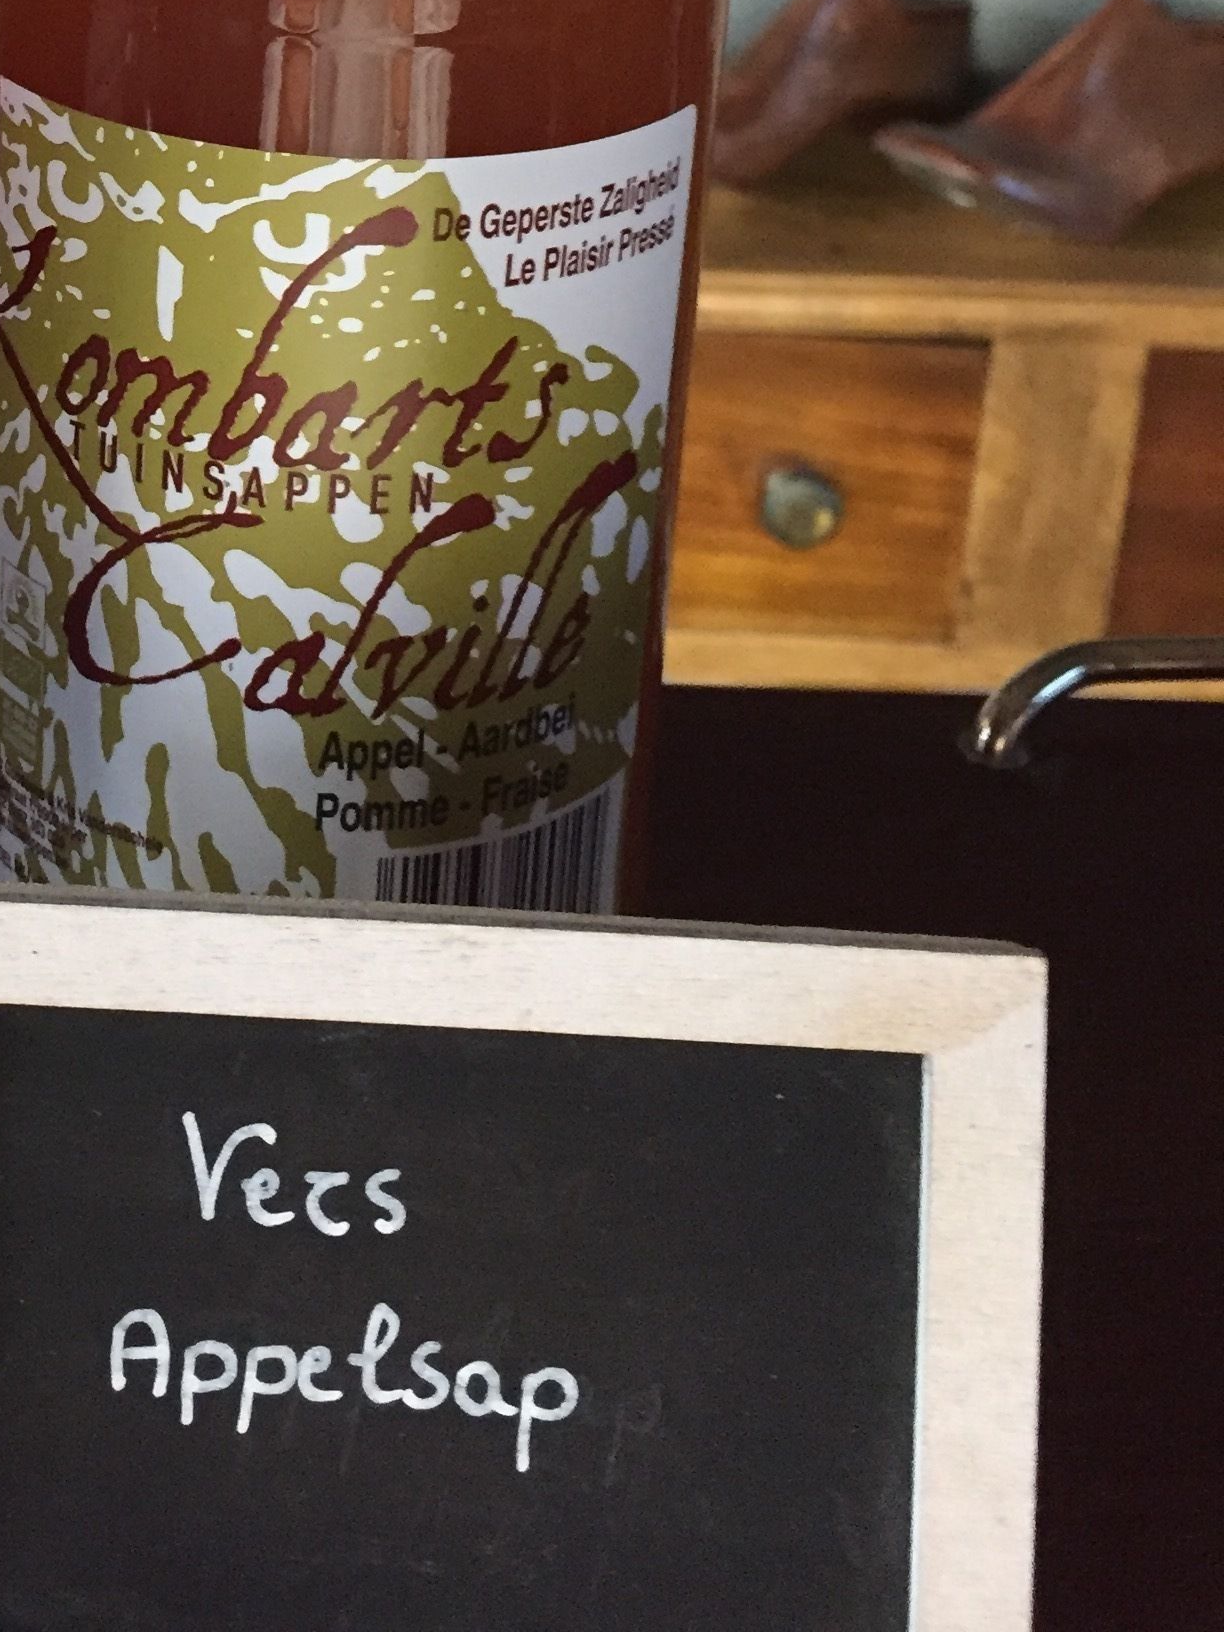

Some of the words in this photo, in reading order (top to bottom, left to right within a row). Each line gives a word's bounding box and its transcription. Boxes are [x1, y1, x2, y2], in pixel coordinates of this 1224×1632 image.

[433, 207, 472, 243] De
[480, 193, 595, 245] Geperste
[598, 156, 681, 218] Zaligheid
[504, 252, 536, 288] Le
[543, 234, 615, 282] Plaisir
[69, 417, 434, 516] TUINSAPPEN
[62, 451, 638, 719] Calville
[317, 728, 426, 782] Appel
[458, 691, 576, 761] Aardbei
[314, 791, 451, 834] Pomme
[481, 761, 570, 815] Fraise
[110, 1302, 579, 1472] Appelsap
